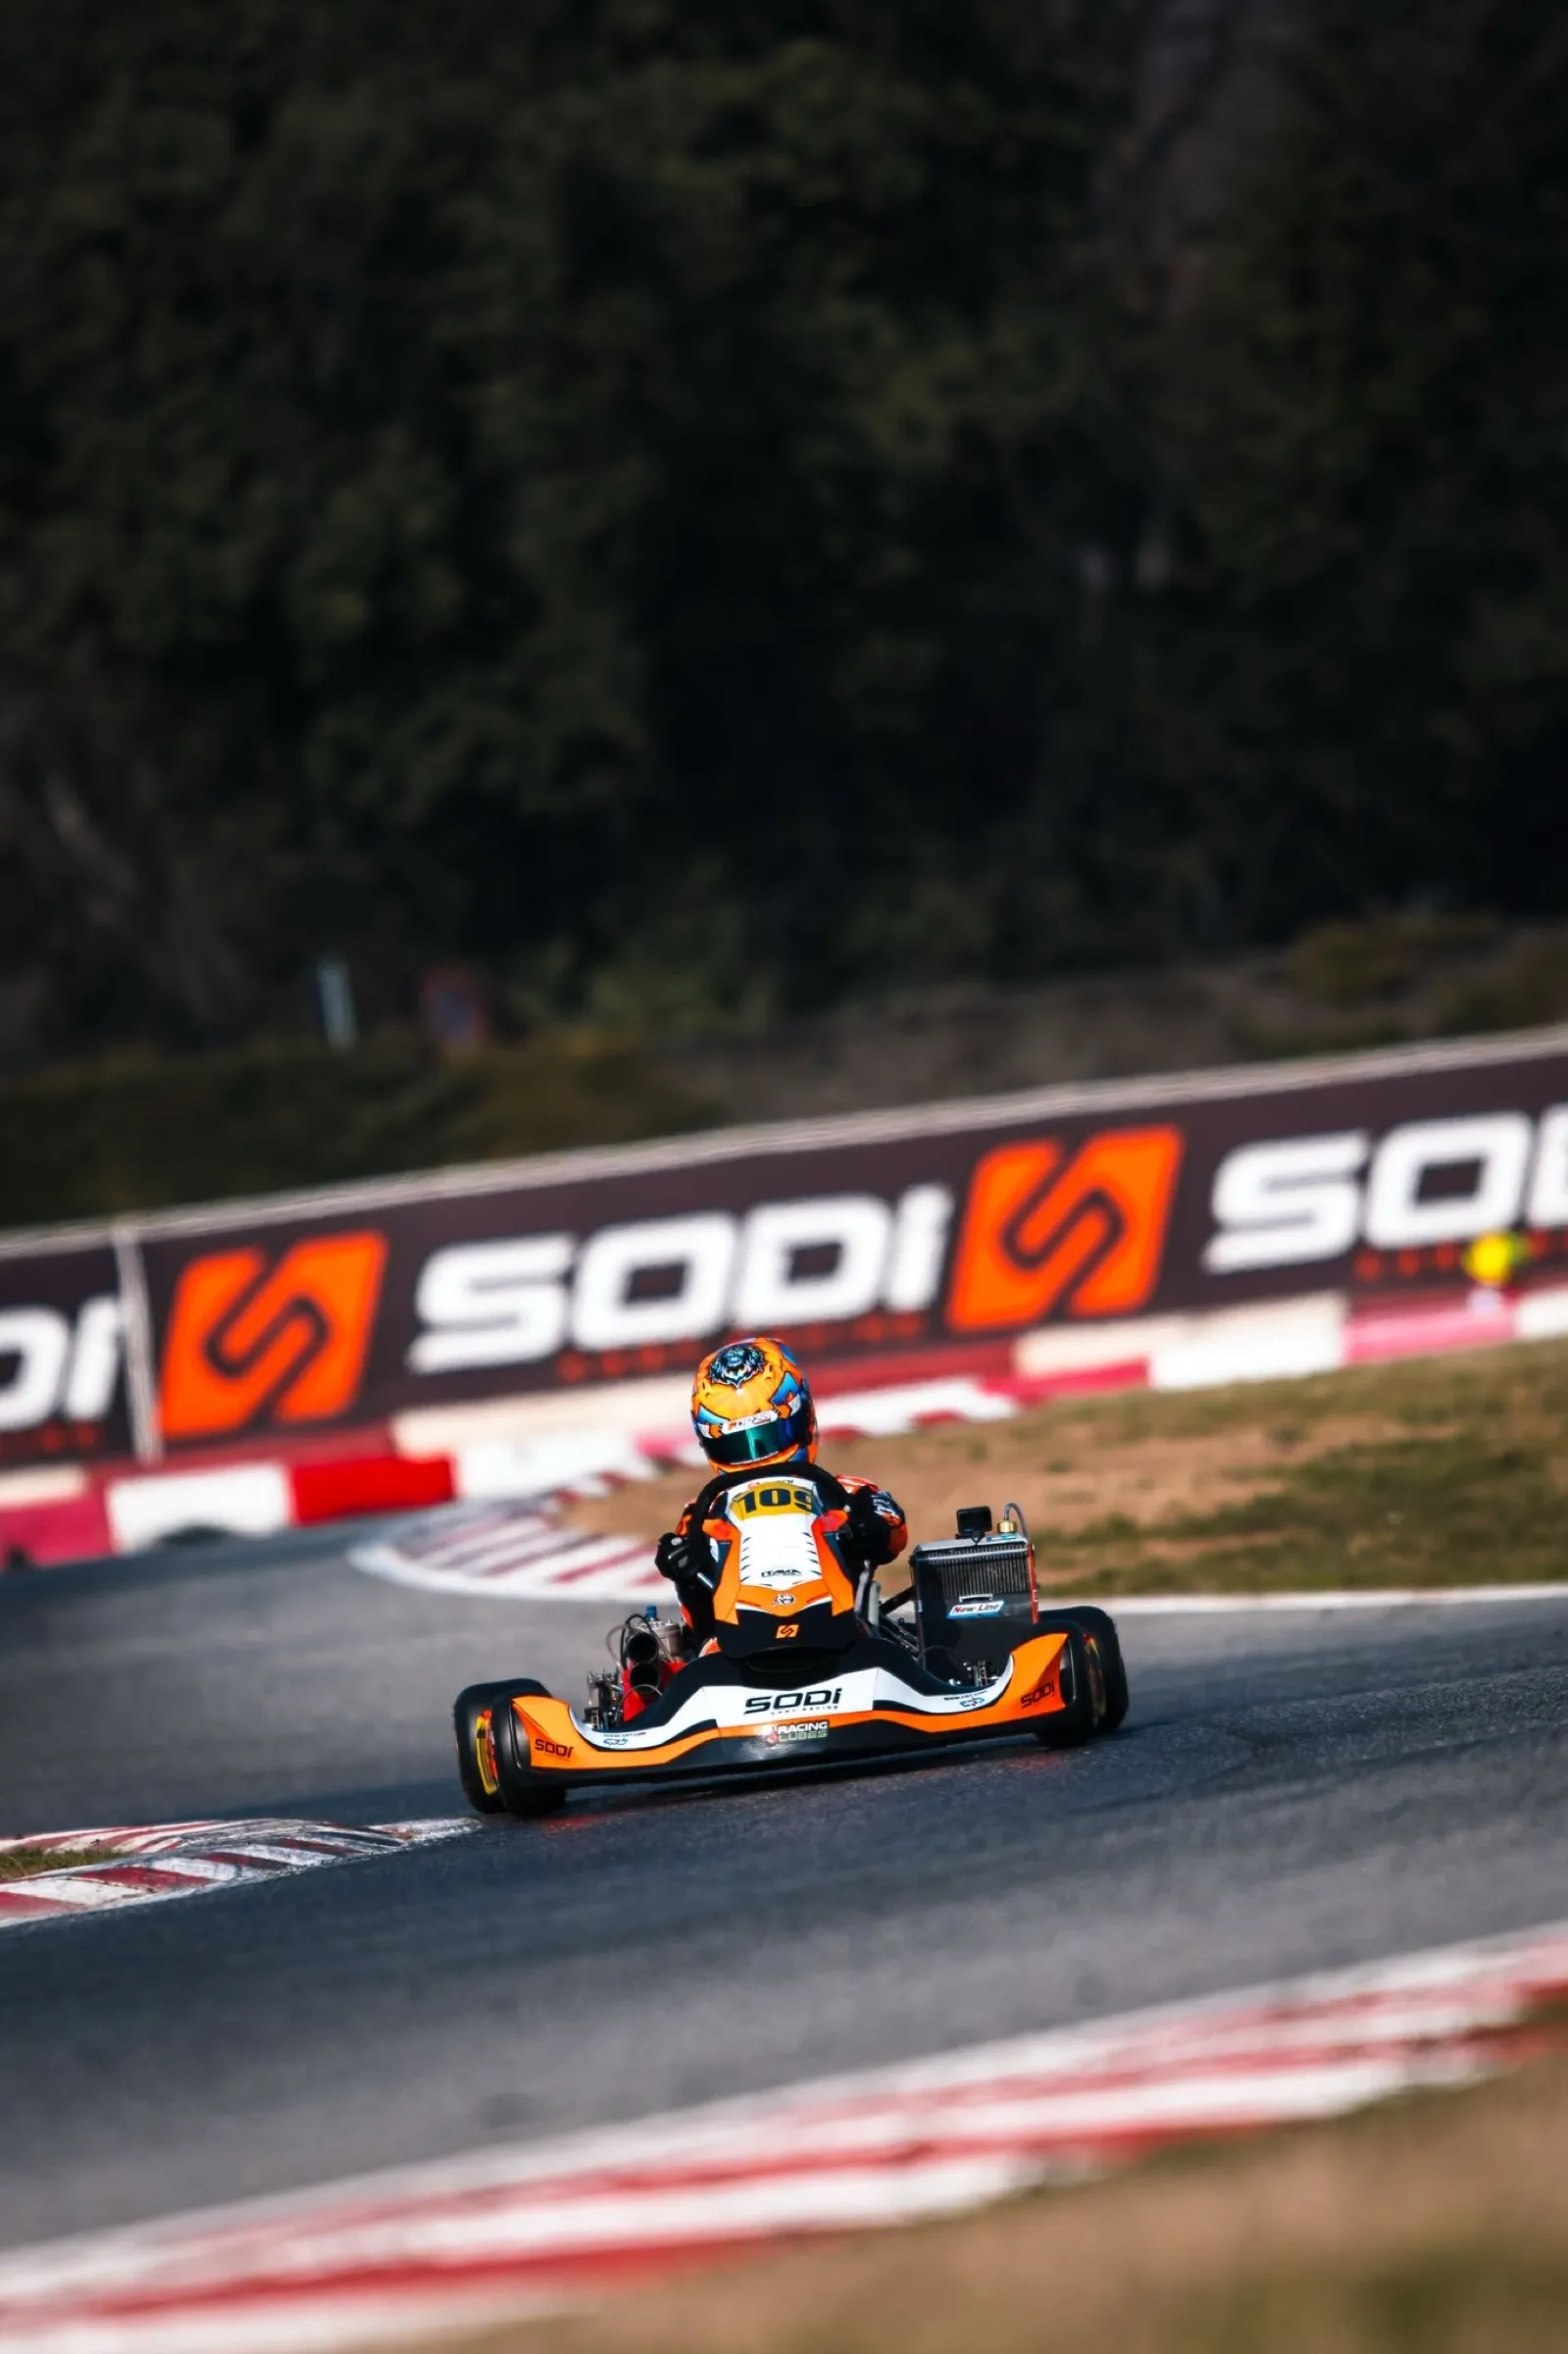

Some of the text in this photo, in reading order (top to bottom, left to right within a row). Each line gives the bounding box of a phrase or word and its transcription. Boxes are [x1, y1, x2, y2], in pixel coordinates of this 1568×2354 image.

[1199, 1103, 1568, 1274] SO
[404, 1183, 954, 1373] SODI
[743, 1687, 842, 1715] SODI
[778, 1720, 828, 1734] RACING
[534, 1738, 575, 1759] SODI
